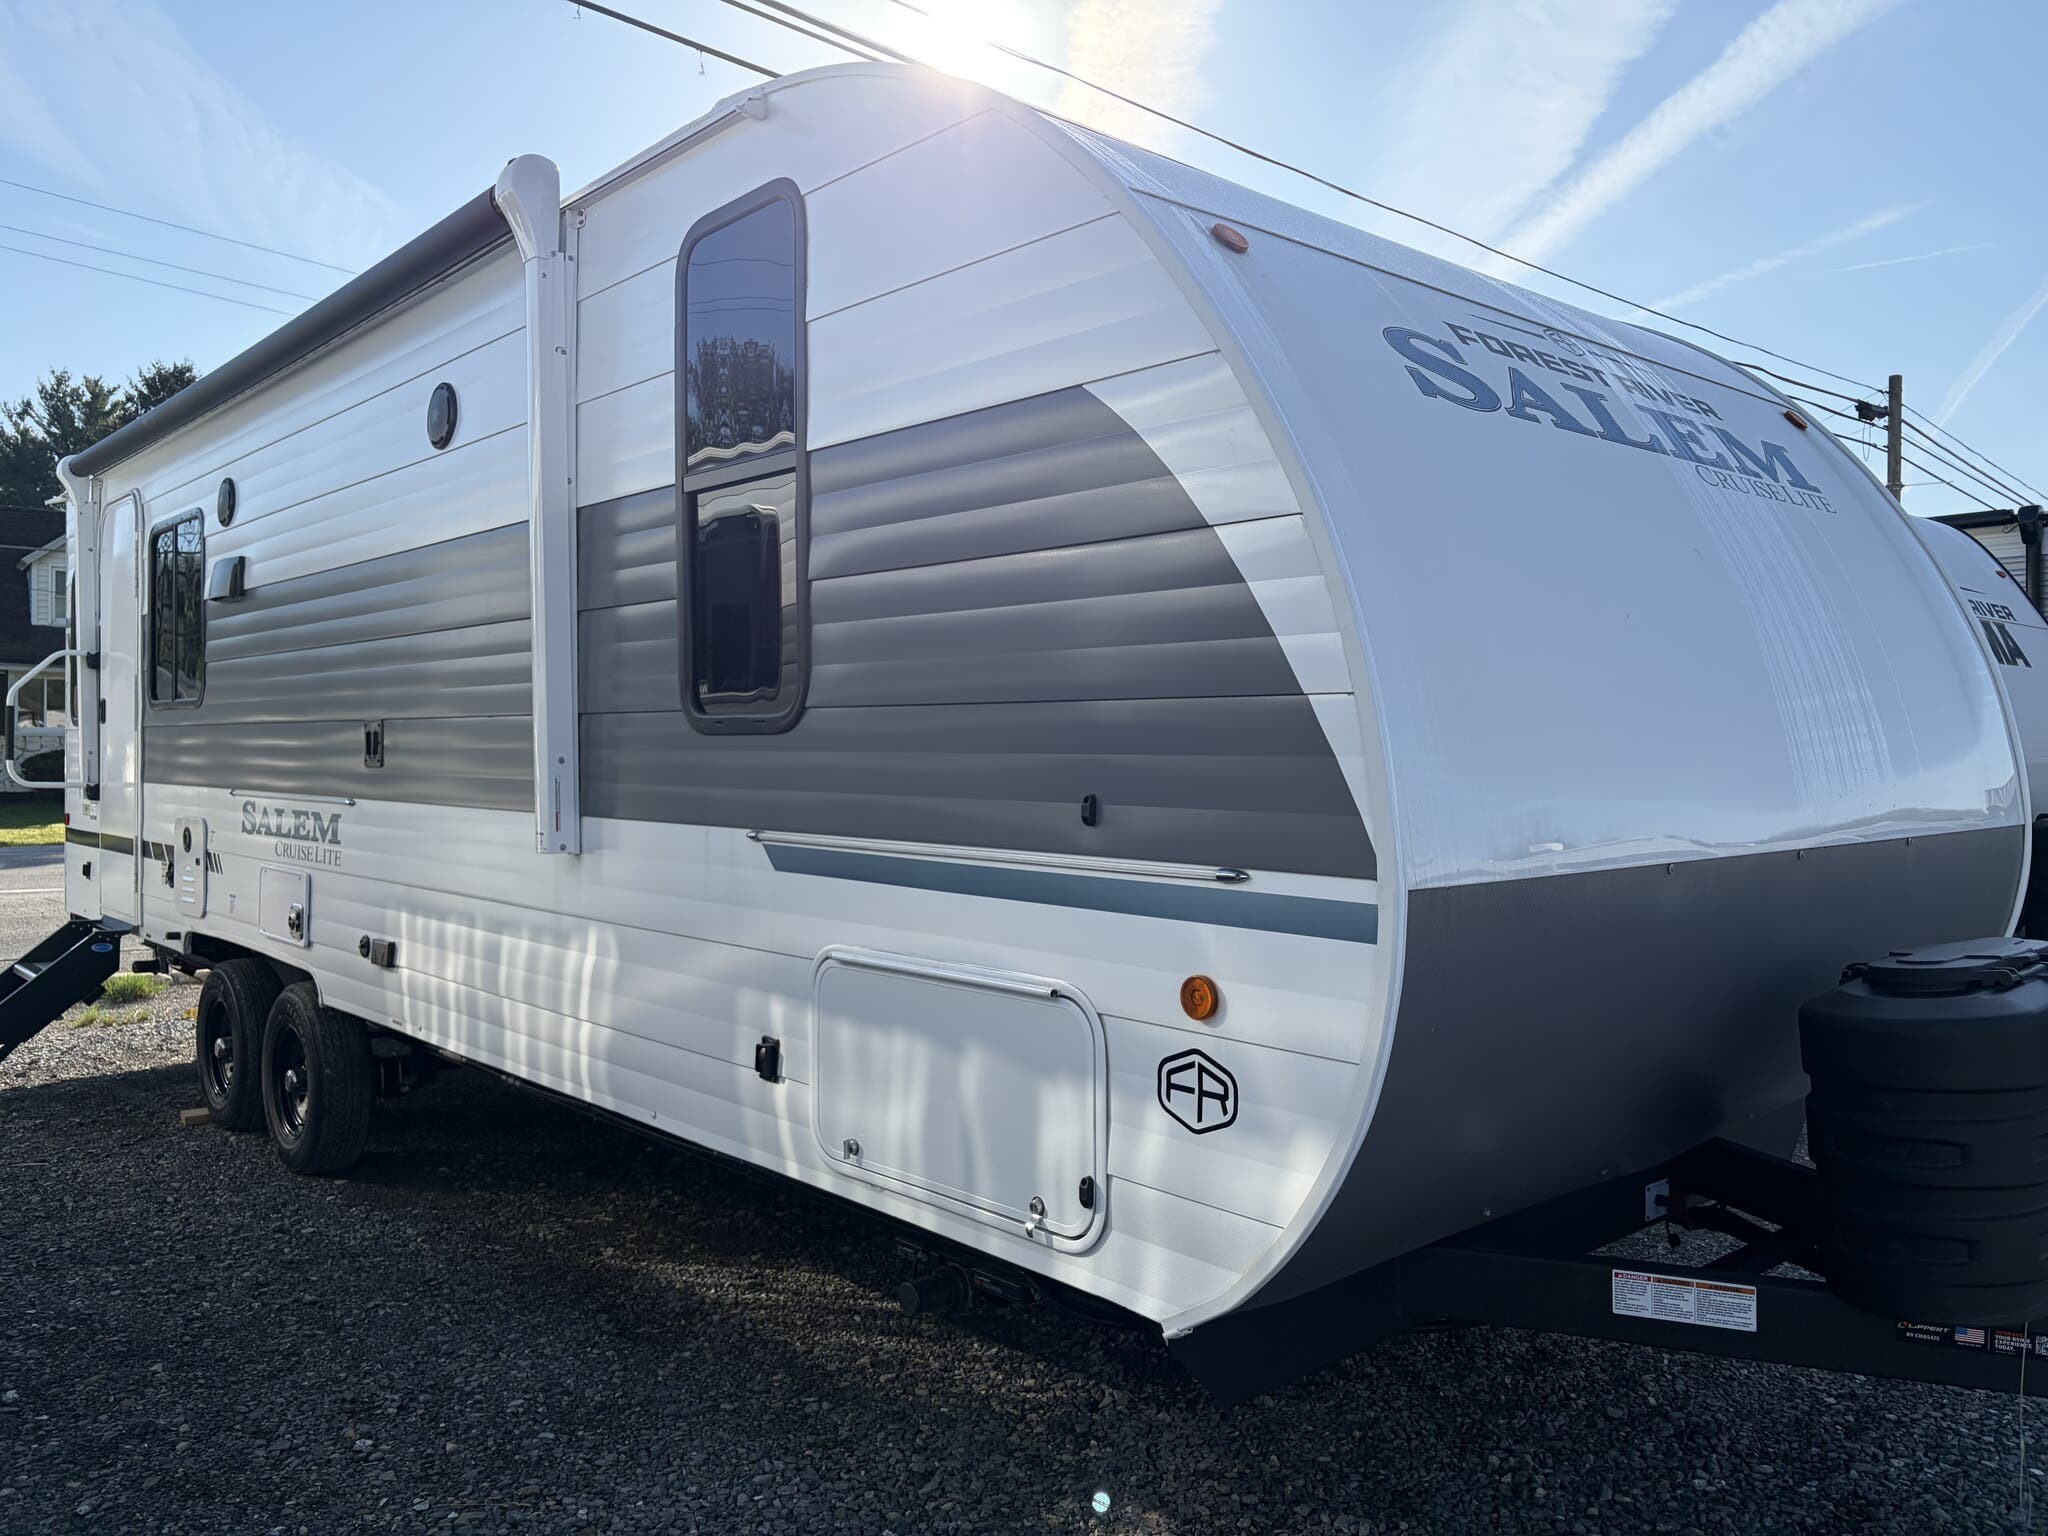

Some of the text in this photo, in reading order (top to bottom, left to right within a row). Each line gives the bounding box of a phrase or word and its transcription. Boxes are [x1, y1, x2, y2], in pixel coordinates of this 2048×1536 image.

[1442, 321, 1724, 421] FOREST RIVER
[1383, 326, 1822, 494] SALEM
[1967, 599, 2018, 621] RIVER
[241, 800, 342, 845] SALEM
